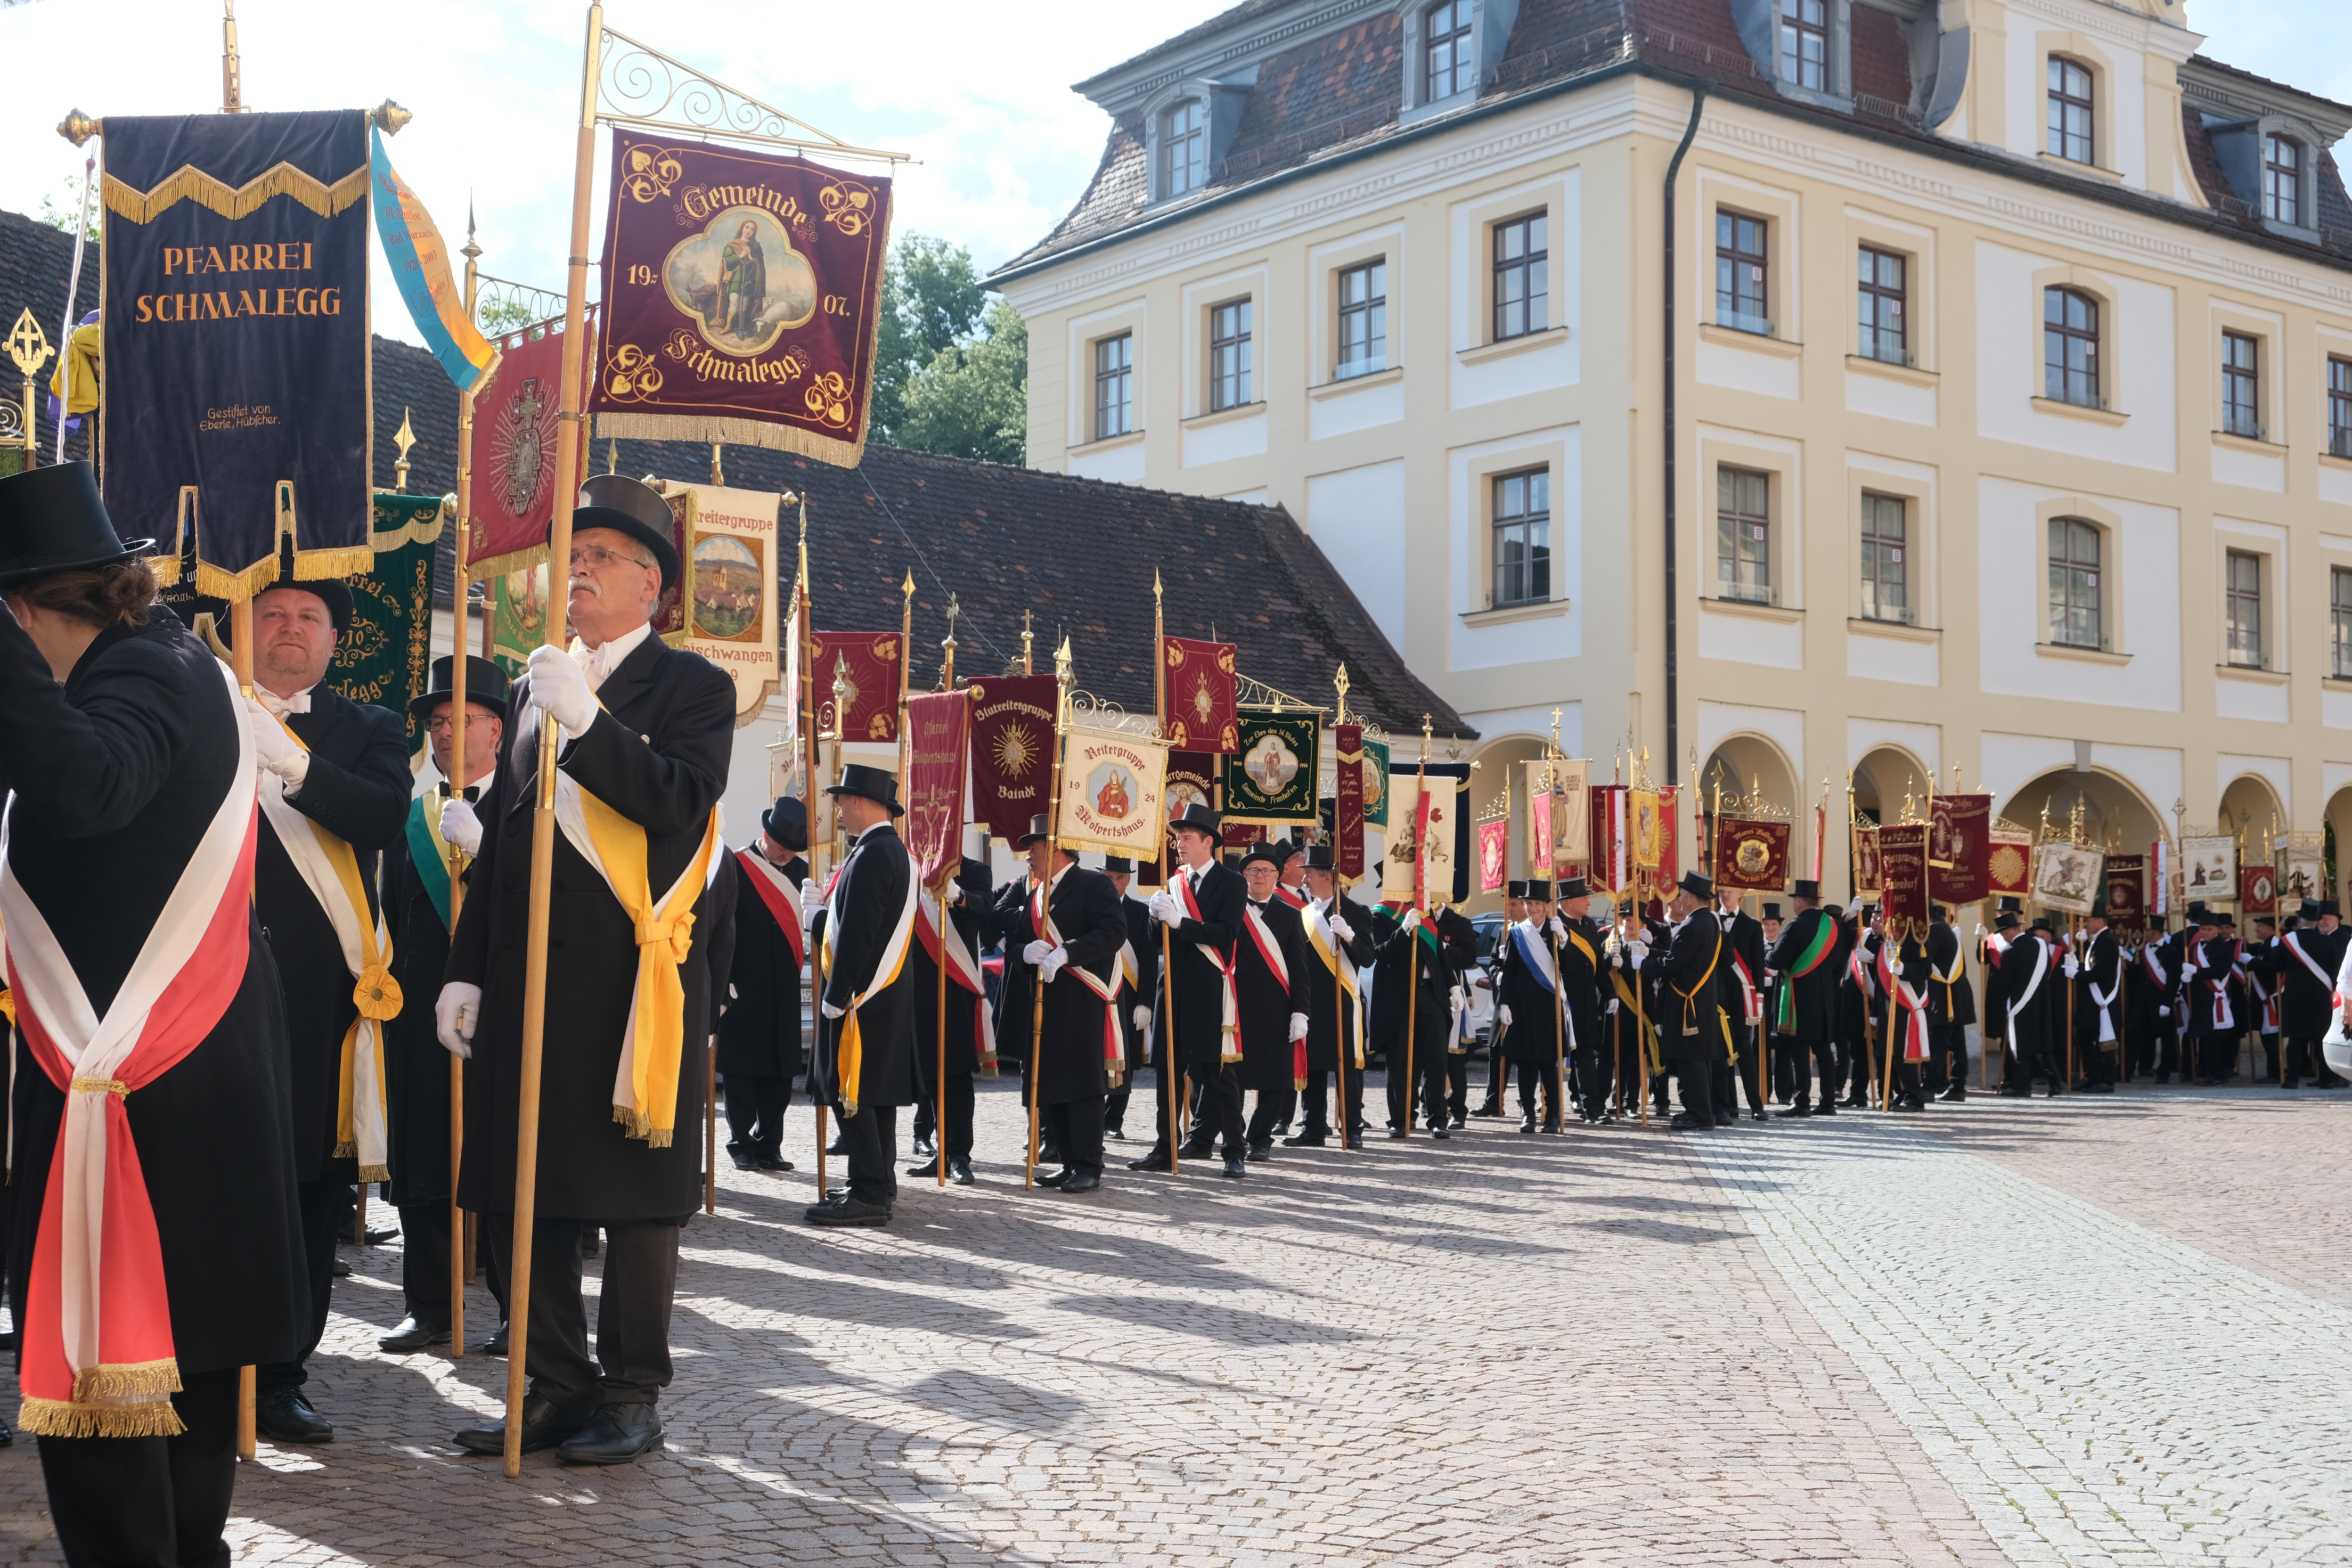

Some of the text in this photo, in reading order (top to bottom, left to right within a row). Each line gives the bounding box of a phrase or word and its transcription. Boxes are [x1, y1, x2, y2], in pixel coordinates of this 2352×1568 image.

[396, 207, 422, 221] Blutfest
[676, 183, 811, 229] Gemeinde
[388, 229, 434, 246] Bad Wurzach
[164, 241, 313, 275] PFARREI
[403, 258, 420, 274] 1928
[422, 250, 437, 265] 2003
[136, 285, 341, 323] SCHMALEGG
[207, 404, 271, 420] Gestiftet von
[199, 419, 235, 431] Eberle,
[696, 509, 773, 532] reitergruppe
[683, 642, 773, 664] eischwangen
[974, 699, 1053, 722] Blutreitergruppe
[924, 720, 948, 739] Pfarrei
[1243, 736, 1254, 746] Zur
[1254, 730, 1267, 739] Ehre
[1285, 731, 1298, 747] Blutes
[1083, 744, 1145, 771] Reitergruppe
[1165, 770, 1211, 790] arrgemeinde
[997, 785, 1036, 799] Baindt
[1069, 780, 1155, 803] 19 24
[1242, 782, 1298, 804] Gemeinde Fronhofen
[1074, 805, 1146, 838] Molpertshaus.
